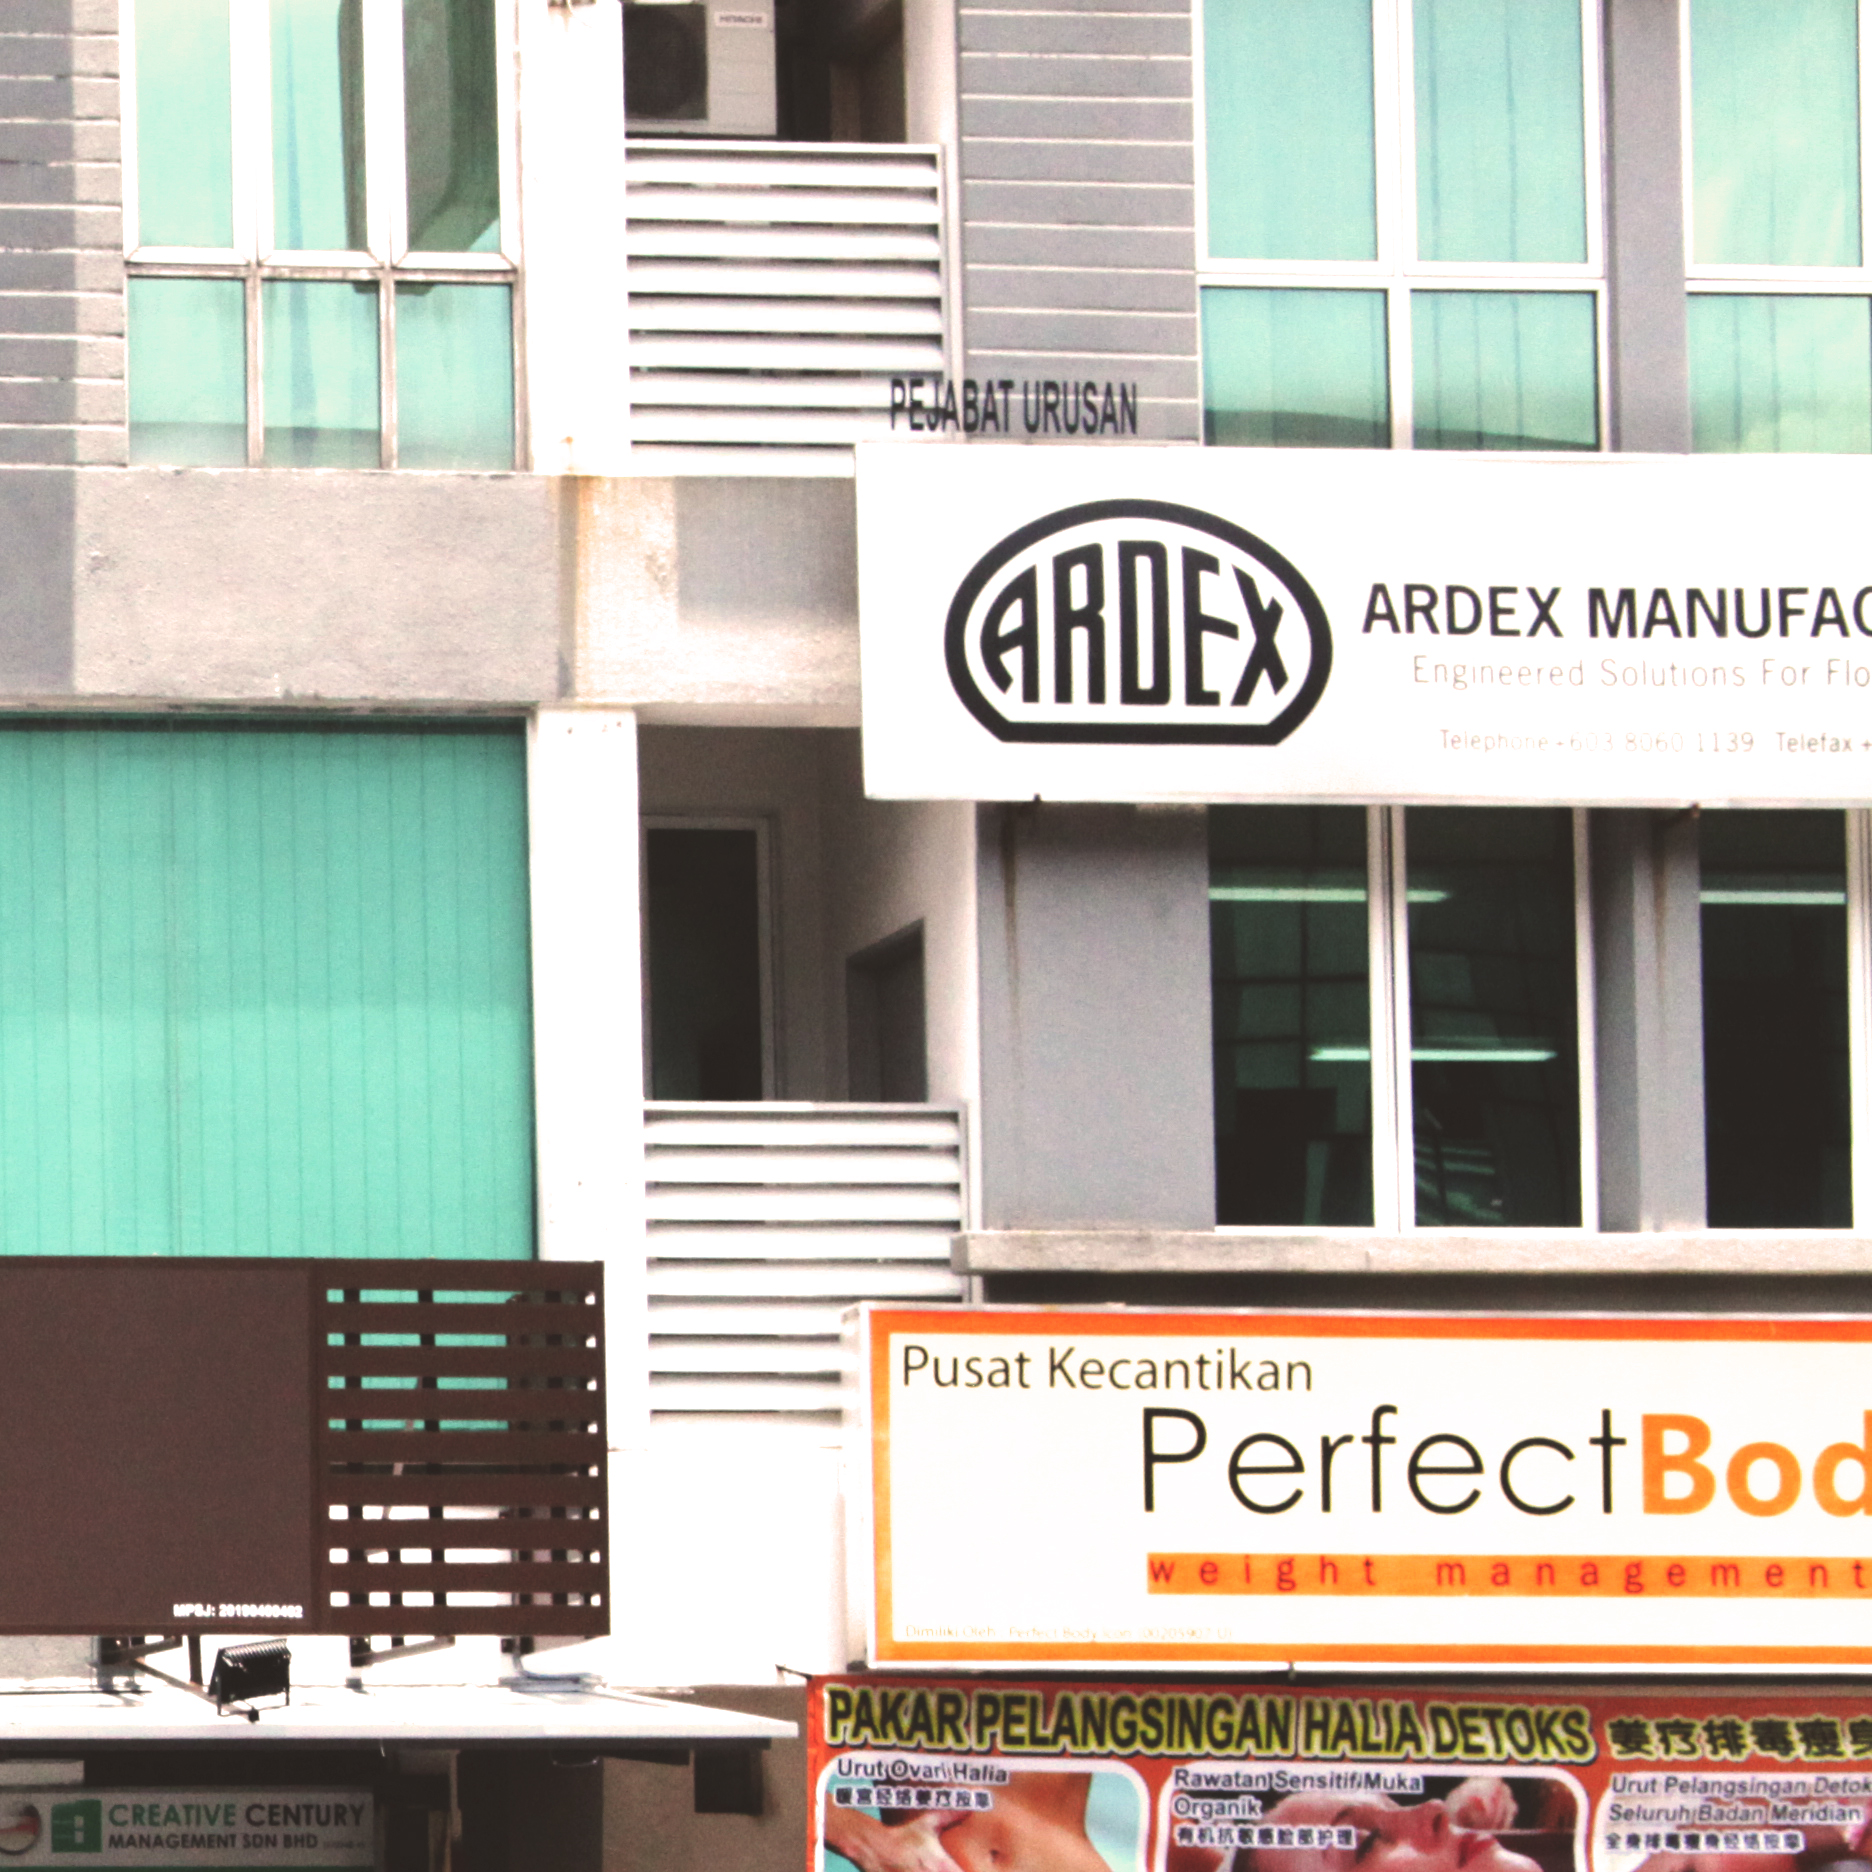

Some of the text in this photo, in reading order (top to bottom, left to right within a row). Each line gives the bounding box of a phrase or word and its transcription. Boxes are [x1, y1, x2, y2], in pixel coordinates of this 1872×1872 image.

[891, 378, 1139, 437] PEJABAT URUSAN
[1362, 581, 1565, 639] ARDEX
[979, 539, 1291, 708] ARDEX
[1413, 654, 1585, 691] Engineered
[1600, 657, 1746, 688] Solutions
[1762, 657, 1812, 688] For
[1439, 728, 1550, 754] Telephone
[1696, 731, 1755, 753] 1139
[1774, 730, 1854, 754] Telefax
[902, 1344, 1314, 1393] Pusat Kecantikan
[1148, 1554, 1378, 1594] weight
[824, 1685, 1597, 1763] PAKAR PELANGSINGAN HALIA DETOKS
[836, 1758, 1009, 1784] Urut Ovari Halia
[1173, 1768, 1423, 1793] Rawatan Sensitif Muka
[1611, 1775, 1658, 1795] Urut
[1663, 1776, 1808, 1798] Pelangsingan
[107, 1803, 366, 1828] CREATIVE CENTURY
[1173, 1796, 1262, 1820] Organik
[1608, 1803, 1862, 1825] Seluruh Badan Meridian
[107, 1832, 237, 1850] MANAGEMENT
[241, 1832, 278, 1850] SDN
[283, 1832, 319, 1850] BHD
